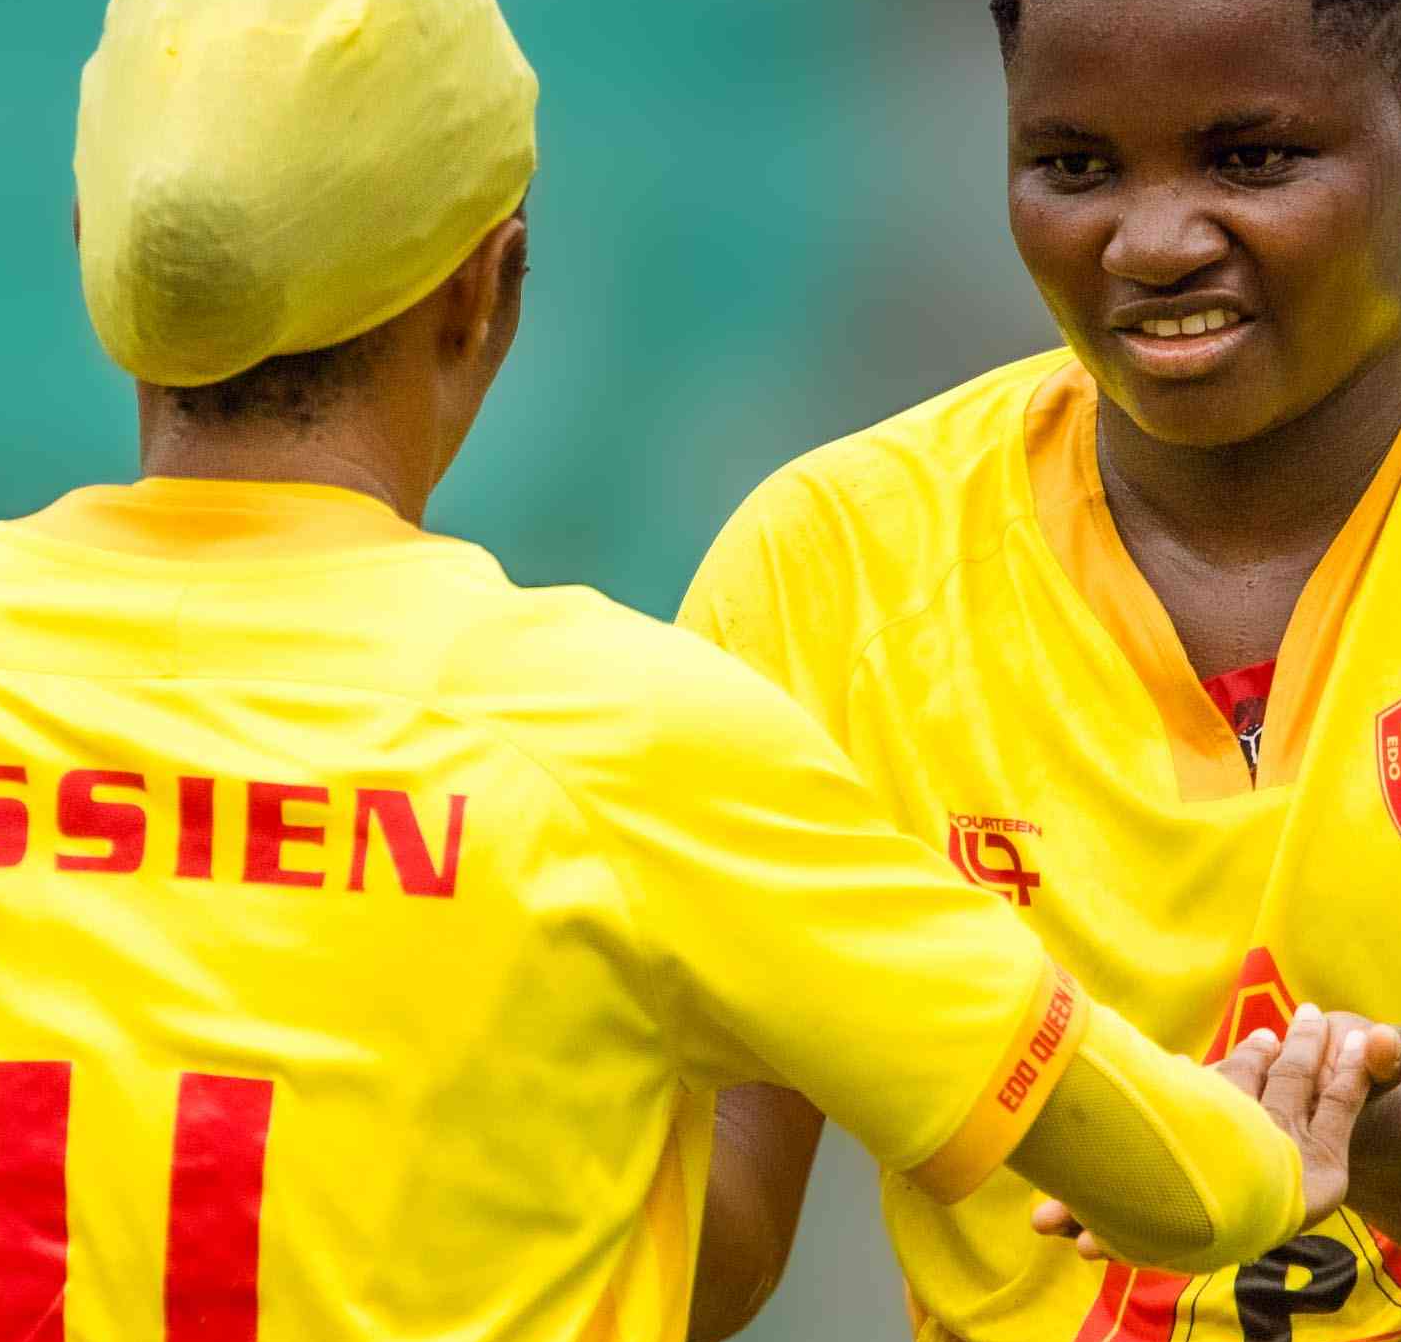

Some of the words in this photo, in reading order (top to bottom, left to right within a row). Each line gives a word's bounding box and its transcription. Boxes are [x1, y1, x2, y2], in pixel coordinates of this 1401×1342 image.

[1385, 734, 1401, 781] EDO
[997, 1059, 1039, 1114] EDO
[1029, 986, 1073, 1065] QUEEN
